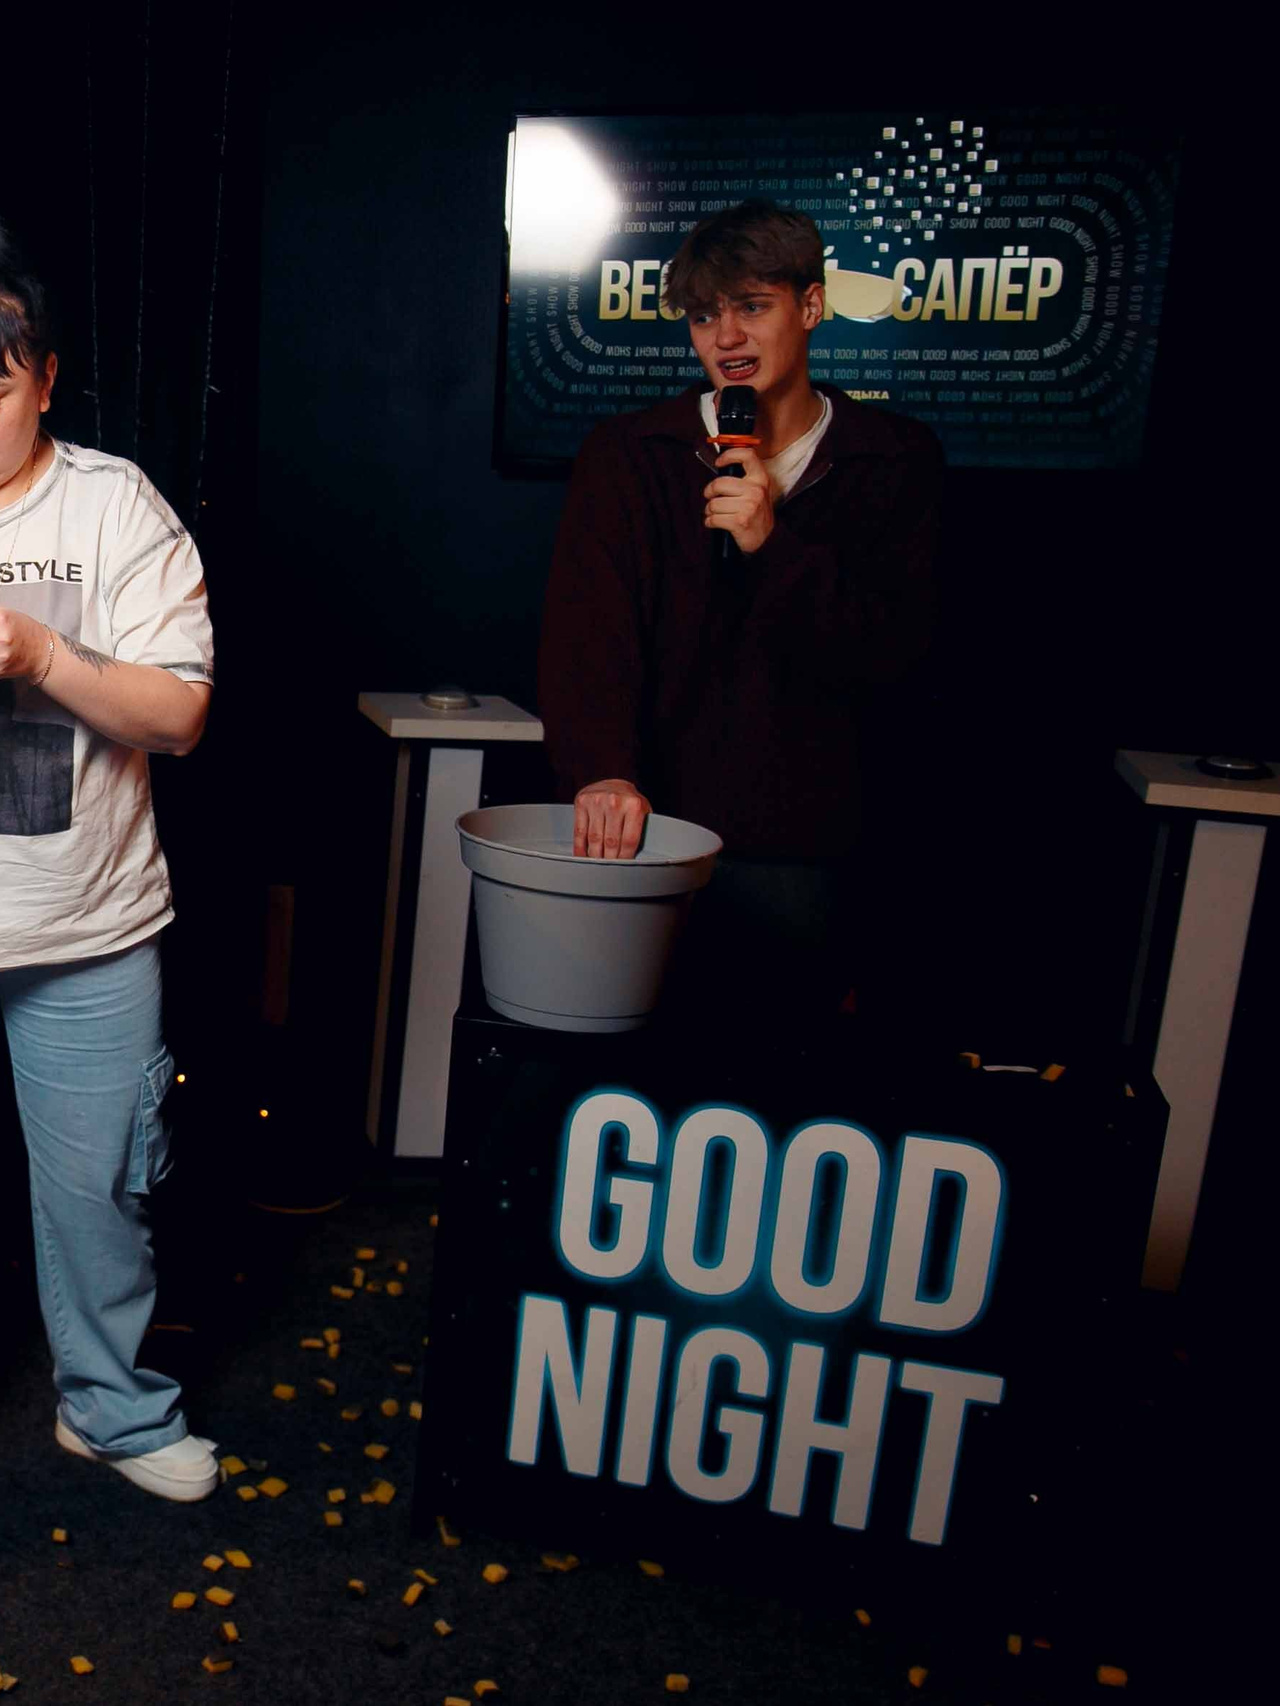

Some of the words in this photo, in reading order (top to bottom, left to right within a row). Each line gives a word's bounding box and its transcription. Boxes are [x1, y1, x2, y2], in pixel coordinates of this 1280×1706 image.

[649, 221, 675, 233] NIGHT
[823, 219, 850, 231] NIGHT
[949, 217, 979, 229] SHOW
[984, 217, 1011, 229] GOOD
[1017, 216, 1045, 229] NIGHT
[892, 245, 1063, 322] САПЁР
[1084, 255, 1099, 284] SHOW
[1081, 286, 1097, 311] GOOD
[559, 1092, 1004, 1334] GOOD
[507, 1294, 1005, 1547] NIGHT
